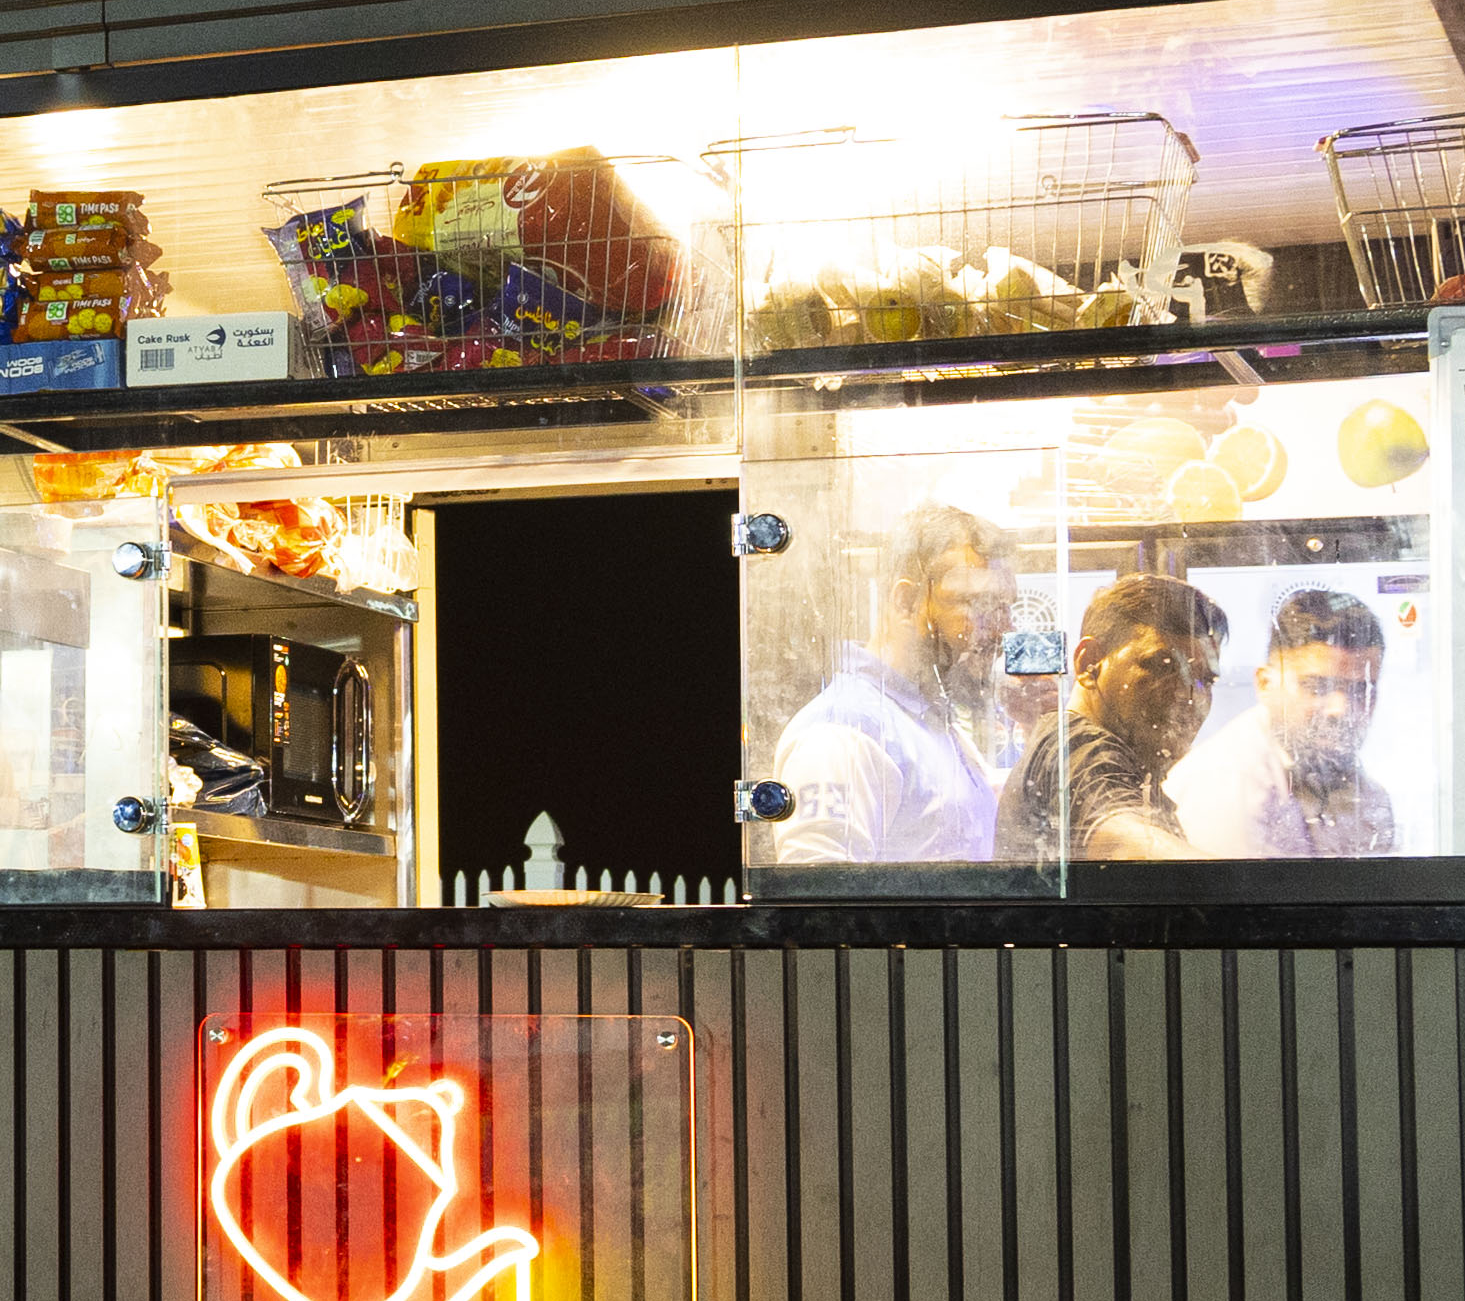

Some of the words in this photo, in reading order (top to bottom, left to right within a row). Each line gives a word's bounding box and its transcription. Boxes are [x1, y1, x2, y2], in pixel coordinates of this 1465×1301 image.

[80, 203, 99, 214] TIME
[100, 202, 120, 214] PASS
[72, 256, 92, 265] TIME
[92, 255, 112, 264] PASS
[73, 300, 91, 308] TIME
[92, 298, 112, 308] PASS
[232, 328, 274, 337] بسكويت
[138, 335, 162, 345] Cake
[166, 334, 190, 343] Rusk
[237, 338, 274, 348] الكعكة
[6, 356, 43, 367] BOOM
